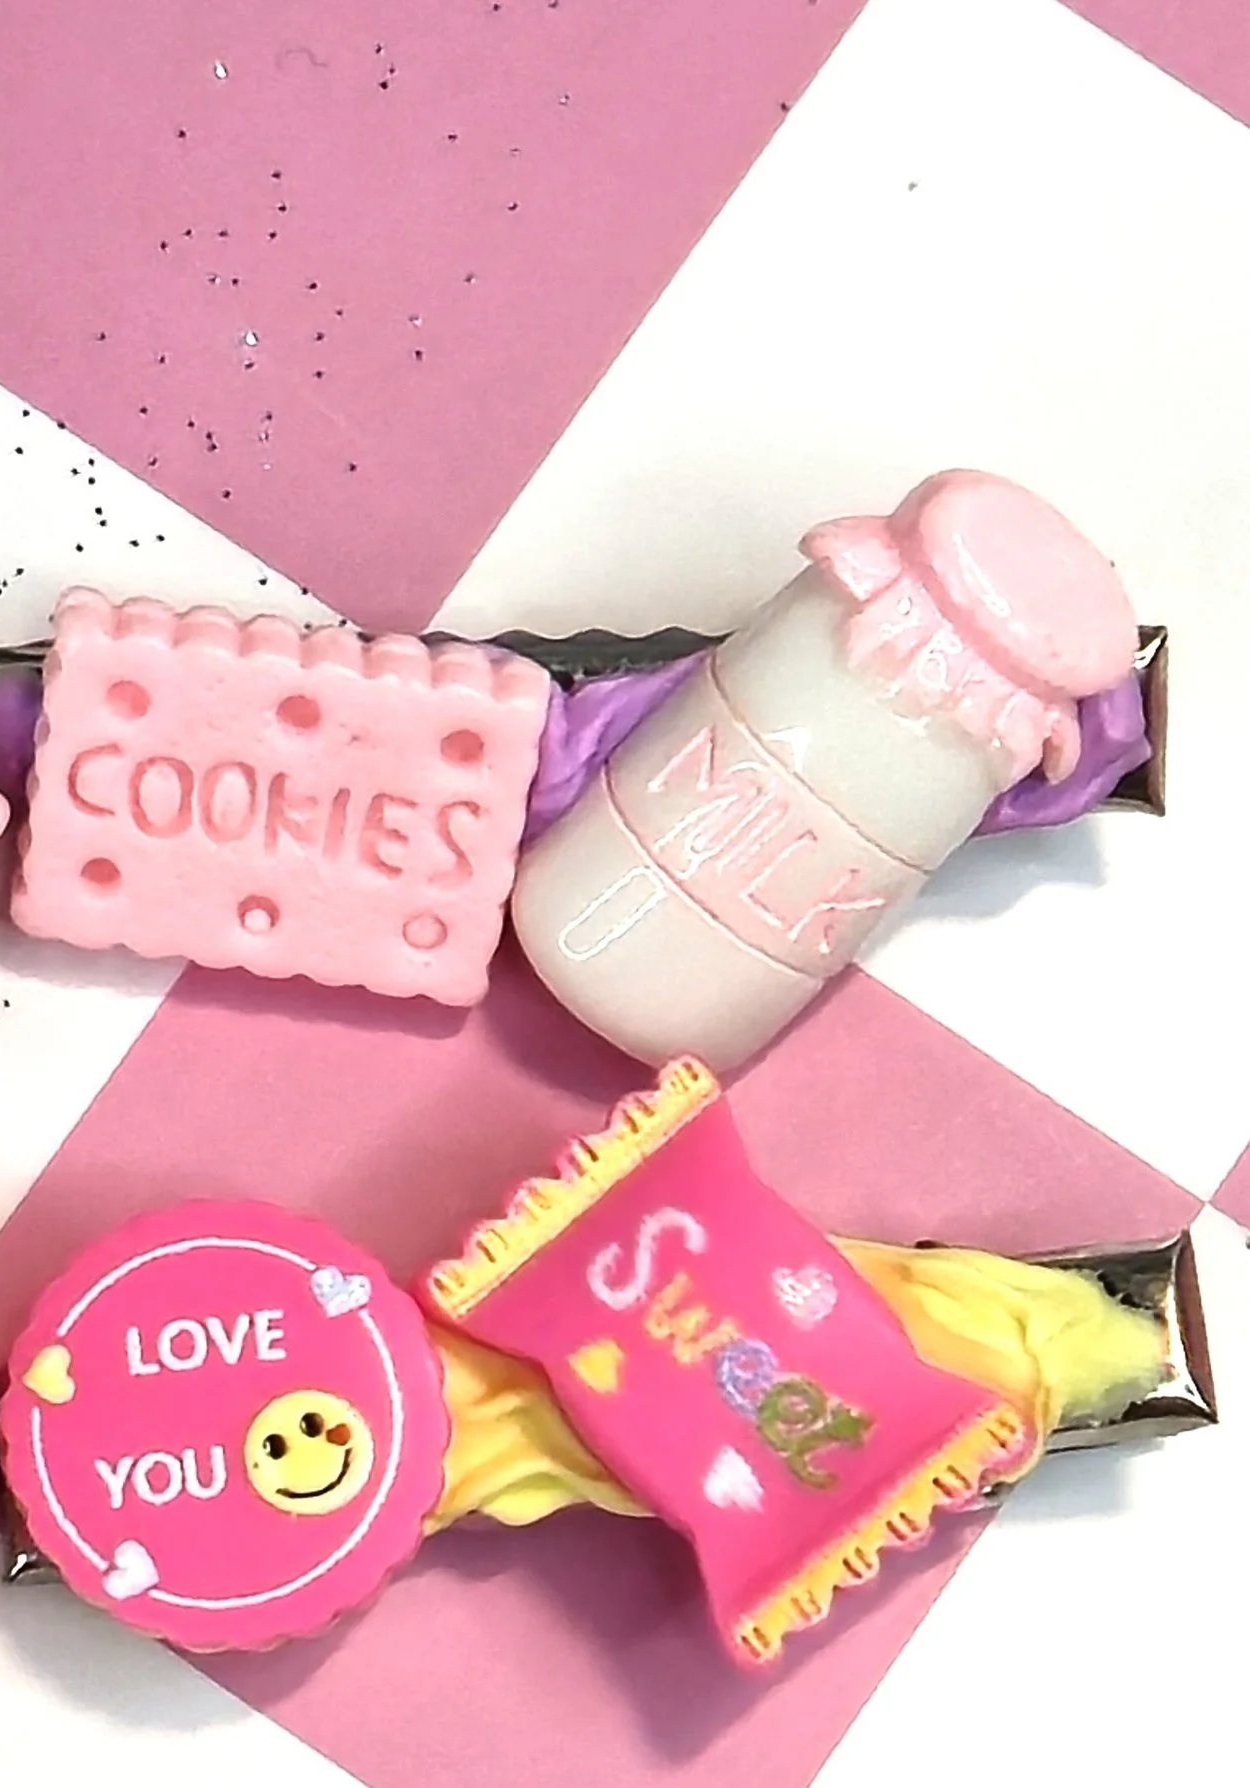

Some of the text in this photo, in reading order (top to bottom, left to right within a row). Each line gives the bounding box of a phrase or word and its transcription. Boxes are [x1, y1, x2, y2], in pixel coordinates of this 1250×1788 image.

[67, 743, 484, 884] COOKIES
[647, 725, 887, 955] MILK
[126, 1309, 287, 1376] LOVE
[94, 1445, 227, 1509] YOU
